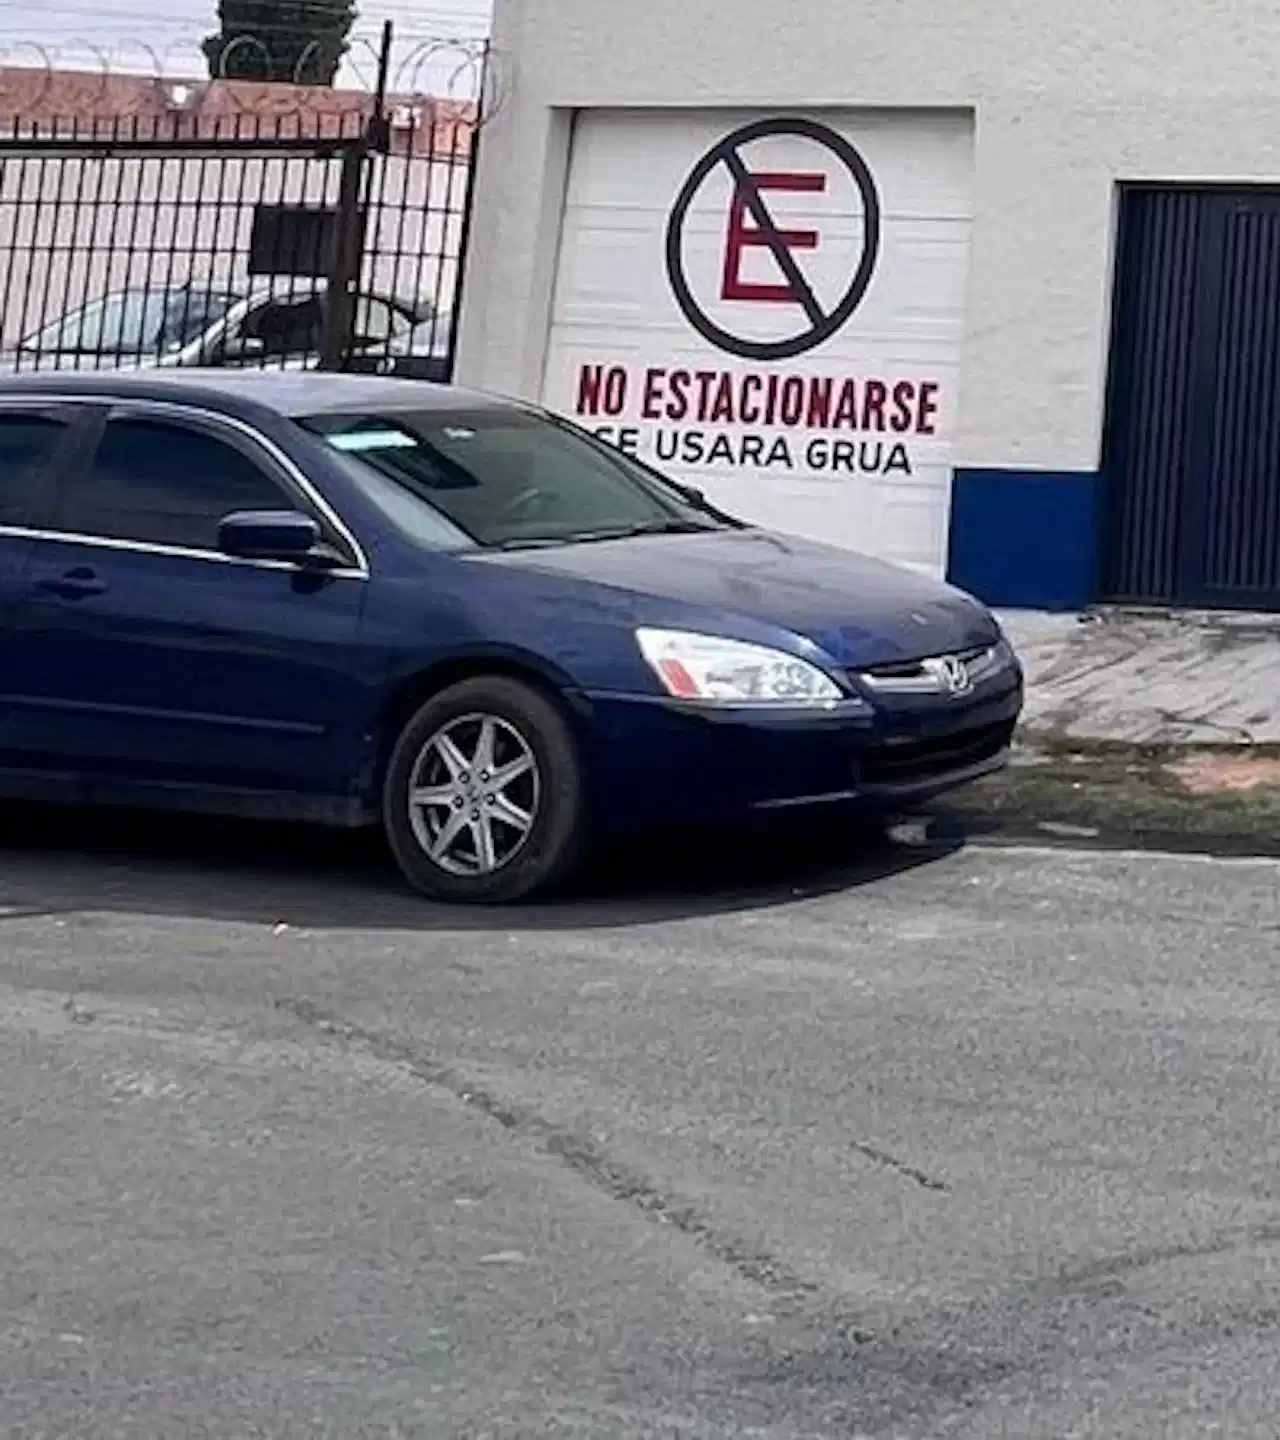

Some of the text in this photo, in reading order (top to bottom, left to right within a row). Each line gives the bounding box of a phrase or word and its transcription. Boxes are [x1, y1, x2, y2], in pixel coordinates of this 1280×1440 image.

[720, 173, 826, 301] E
[577, 364, 938, 435] NO ESTACIONARSE
[656, 429, 793, 467] USARA
[806, 440, 912, 475] GRUA
